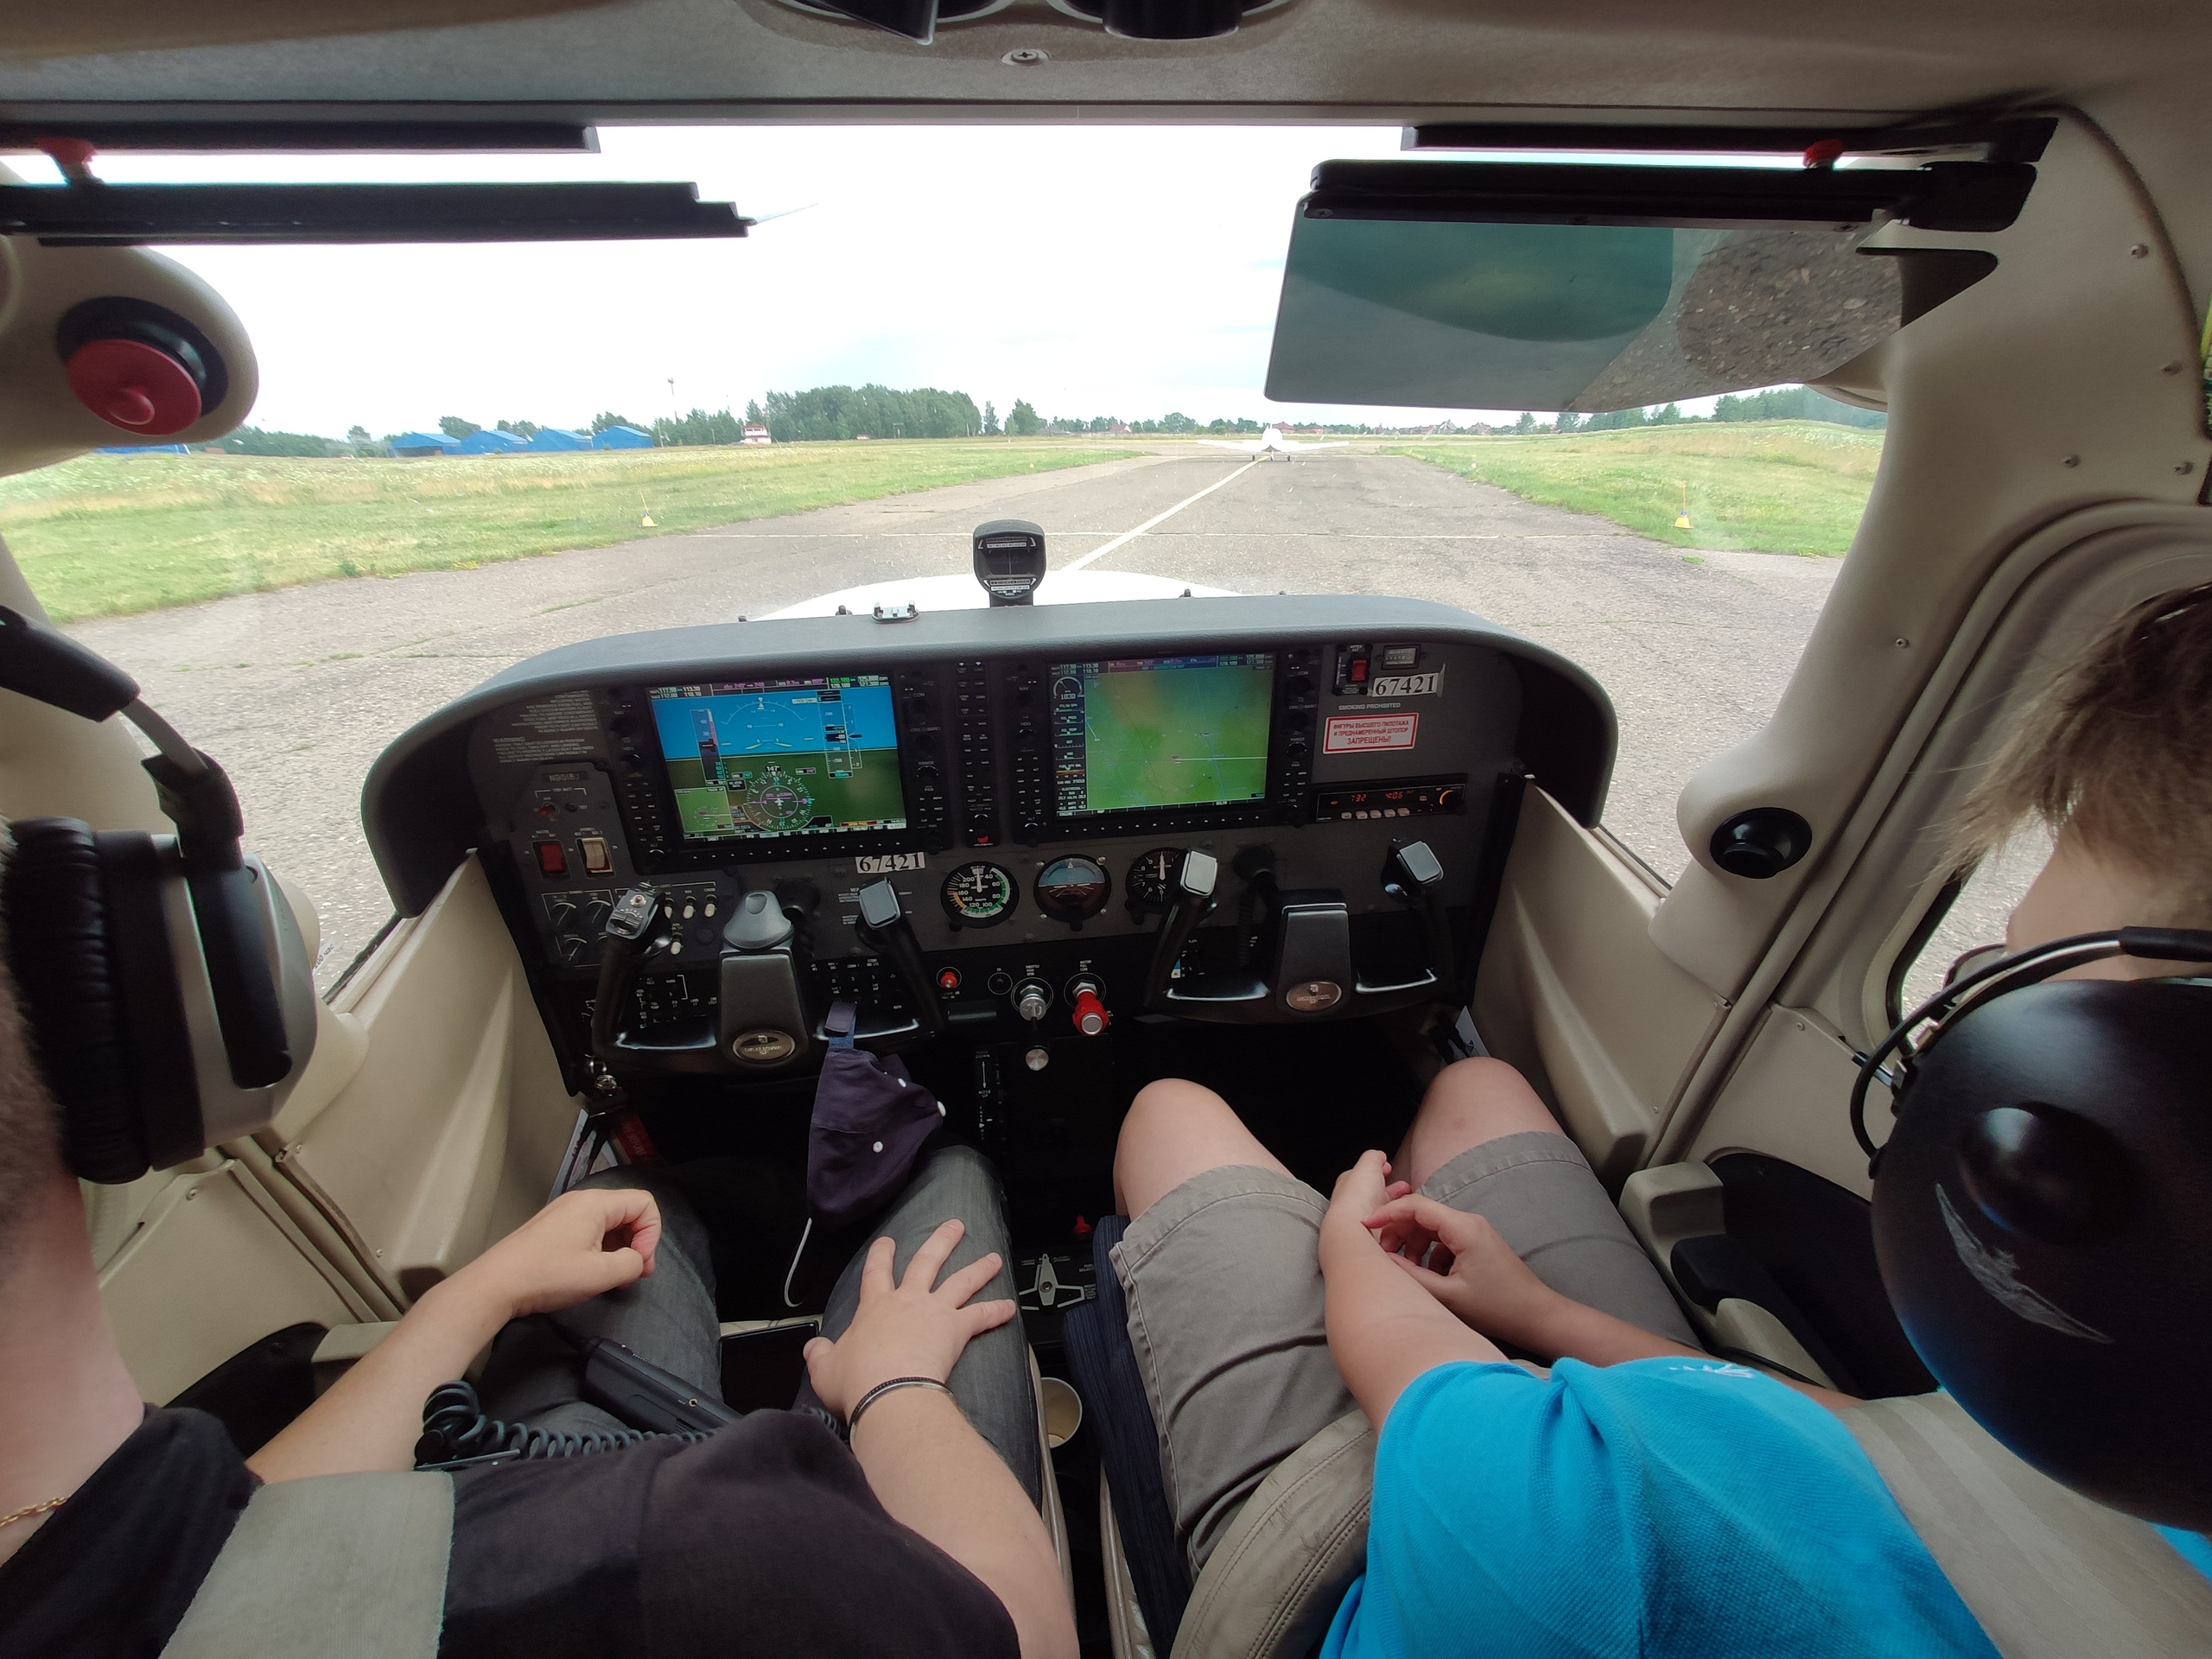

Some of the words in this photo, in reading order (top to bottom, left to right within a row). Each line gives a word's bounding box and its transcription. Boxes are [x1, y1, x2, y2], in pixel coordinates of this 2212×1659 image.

[1375, 675, 1434, 696] 67421
[1338, 728, 1386, 736] ПРЕДНАМЕРЕННЫЙ
[1346, 736, 1391, 745] ЗАПРЕЩЕНЫ!
[859, 853, 921, 872] 67421
